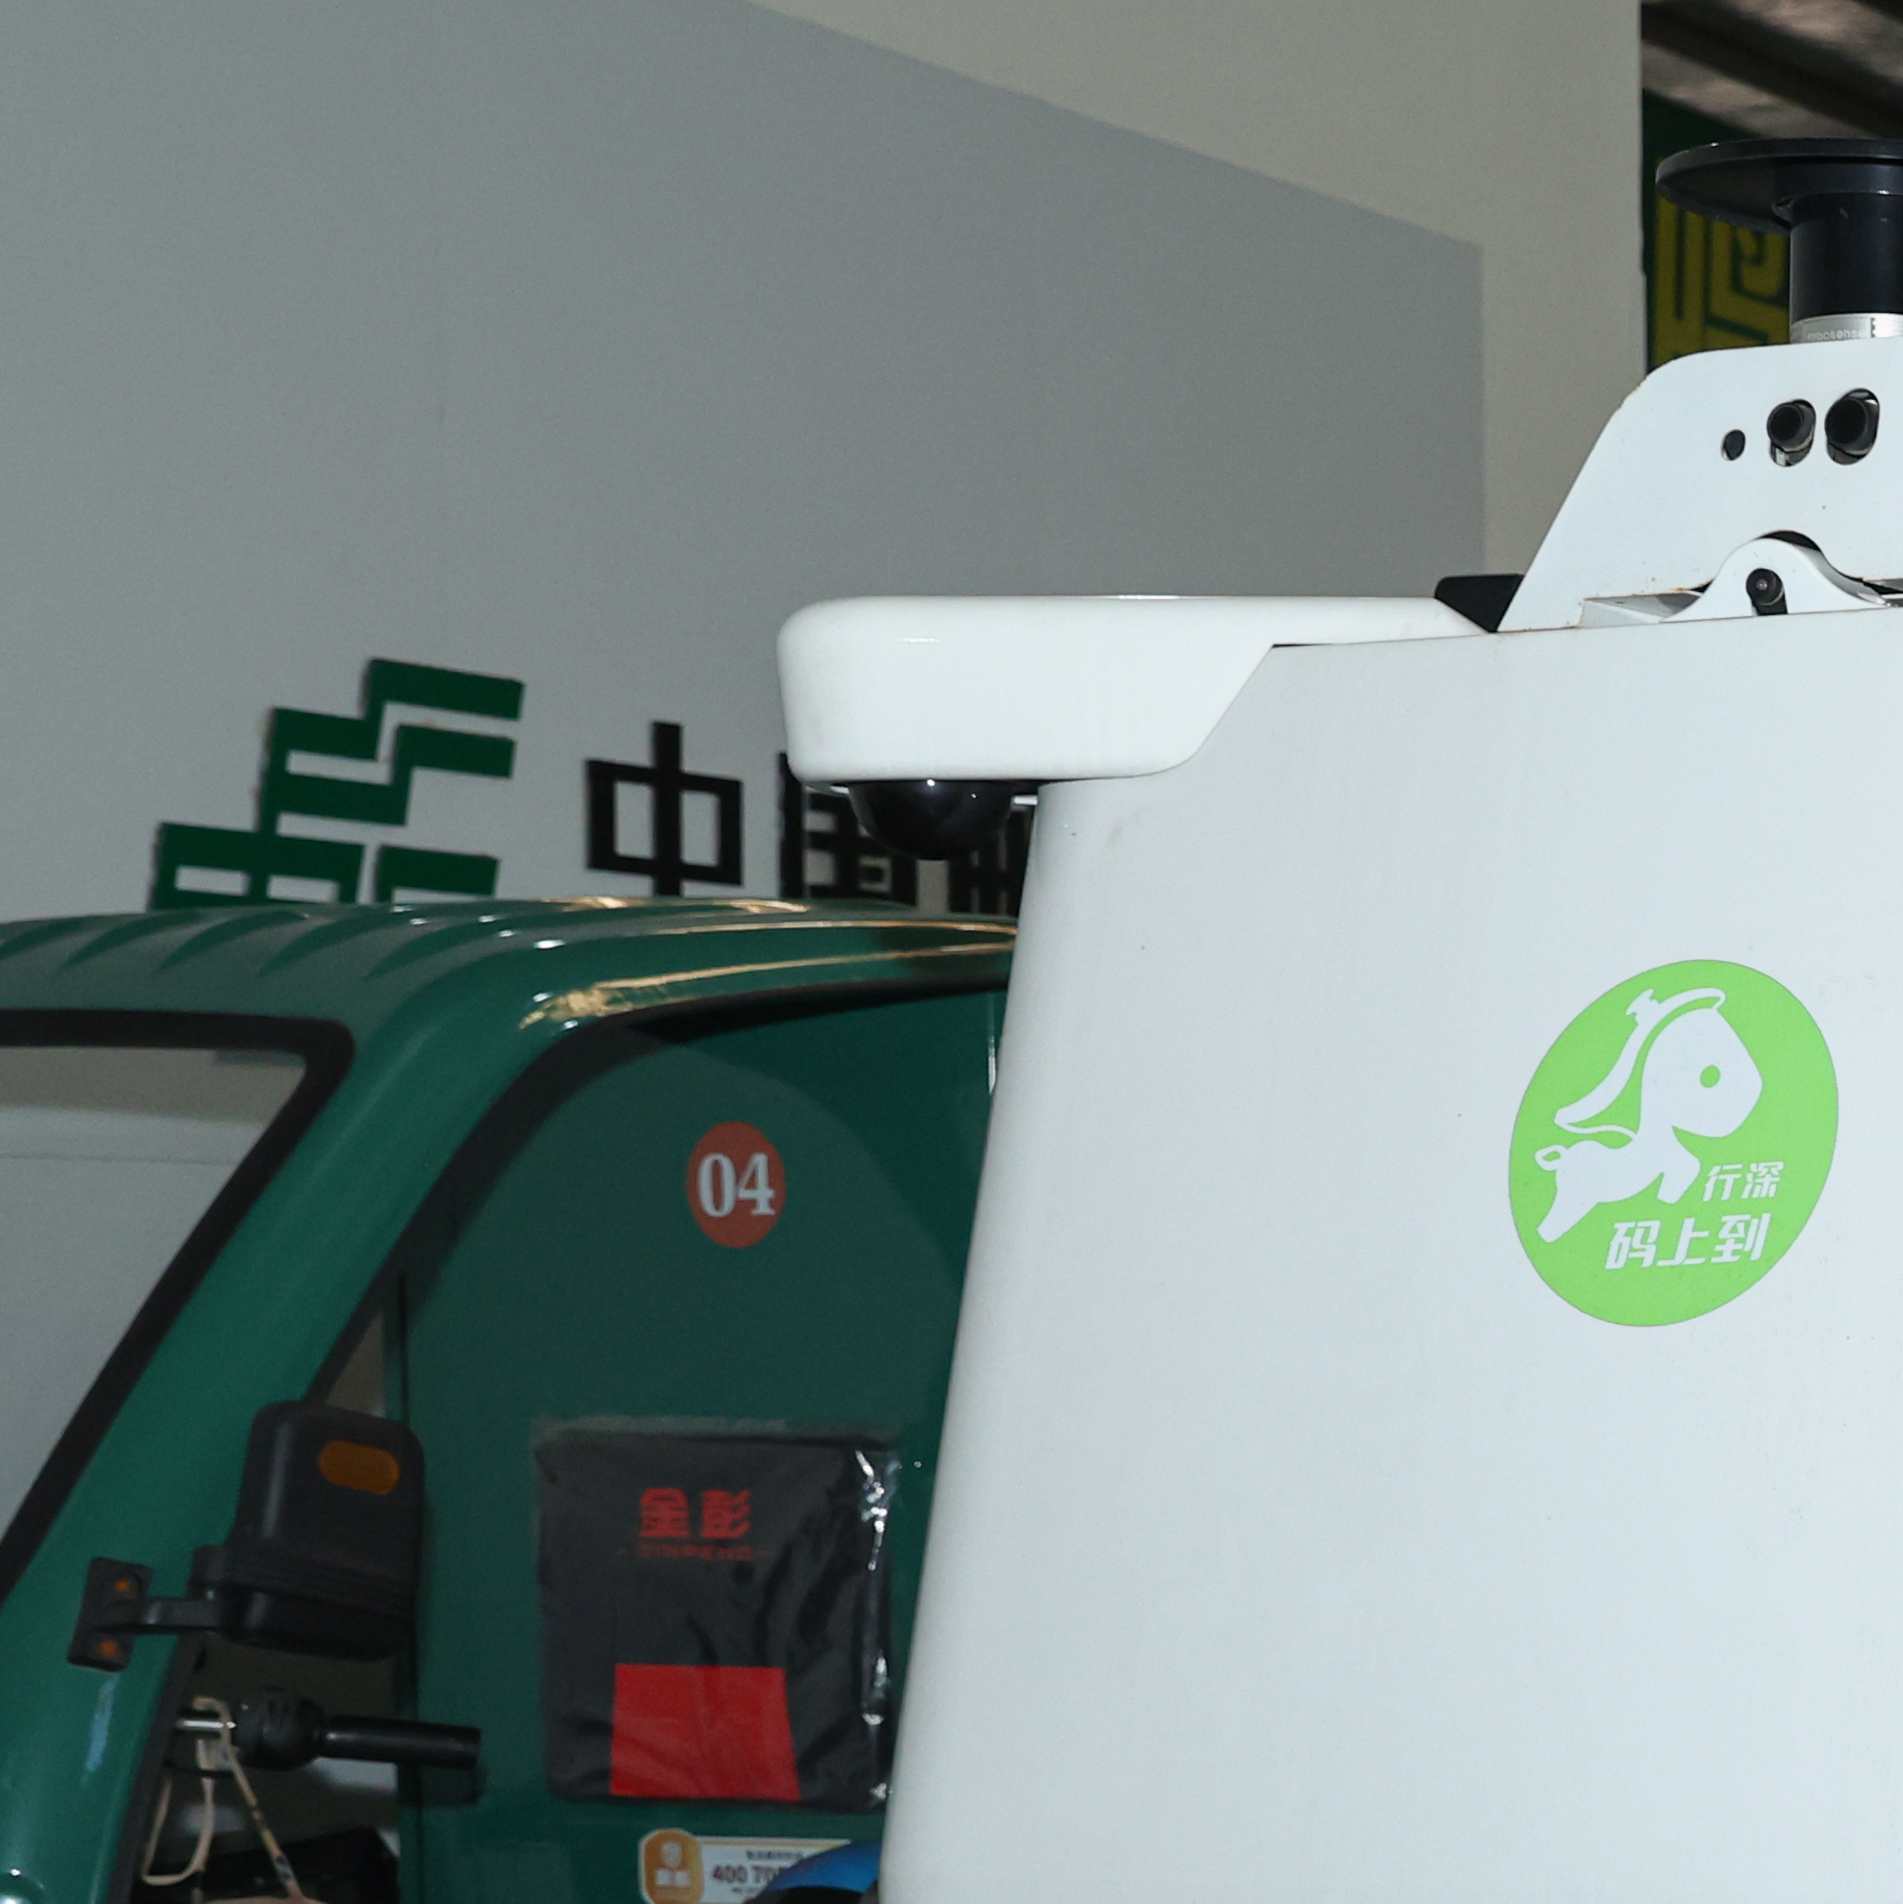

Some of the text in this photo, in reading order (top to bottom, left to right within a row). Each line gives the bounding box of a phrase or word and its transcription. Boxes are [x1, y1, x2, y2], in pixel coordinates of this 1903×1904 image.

[697, 1151, 776, 1218] 04
[1703, 1160, 1785, 1202] 行深
[1605, 1212, 1772, 1270] 码上到
